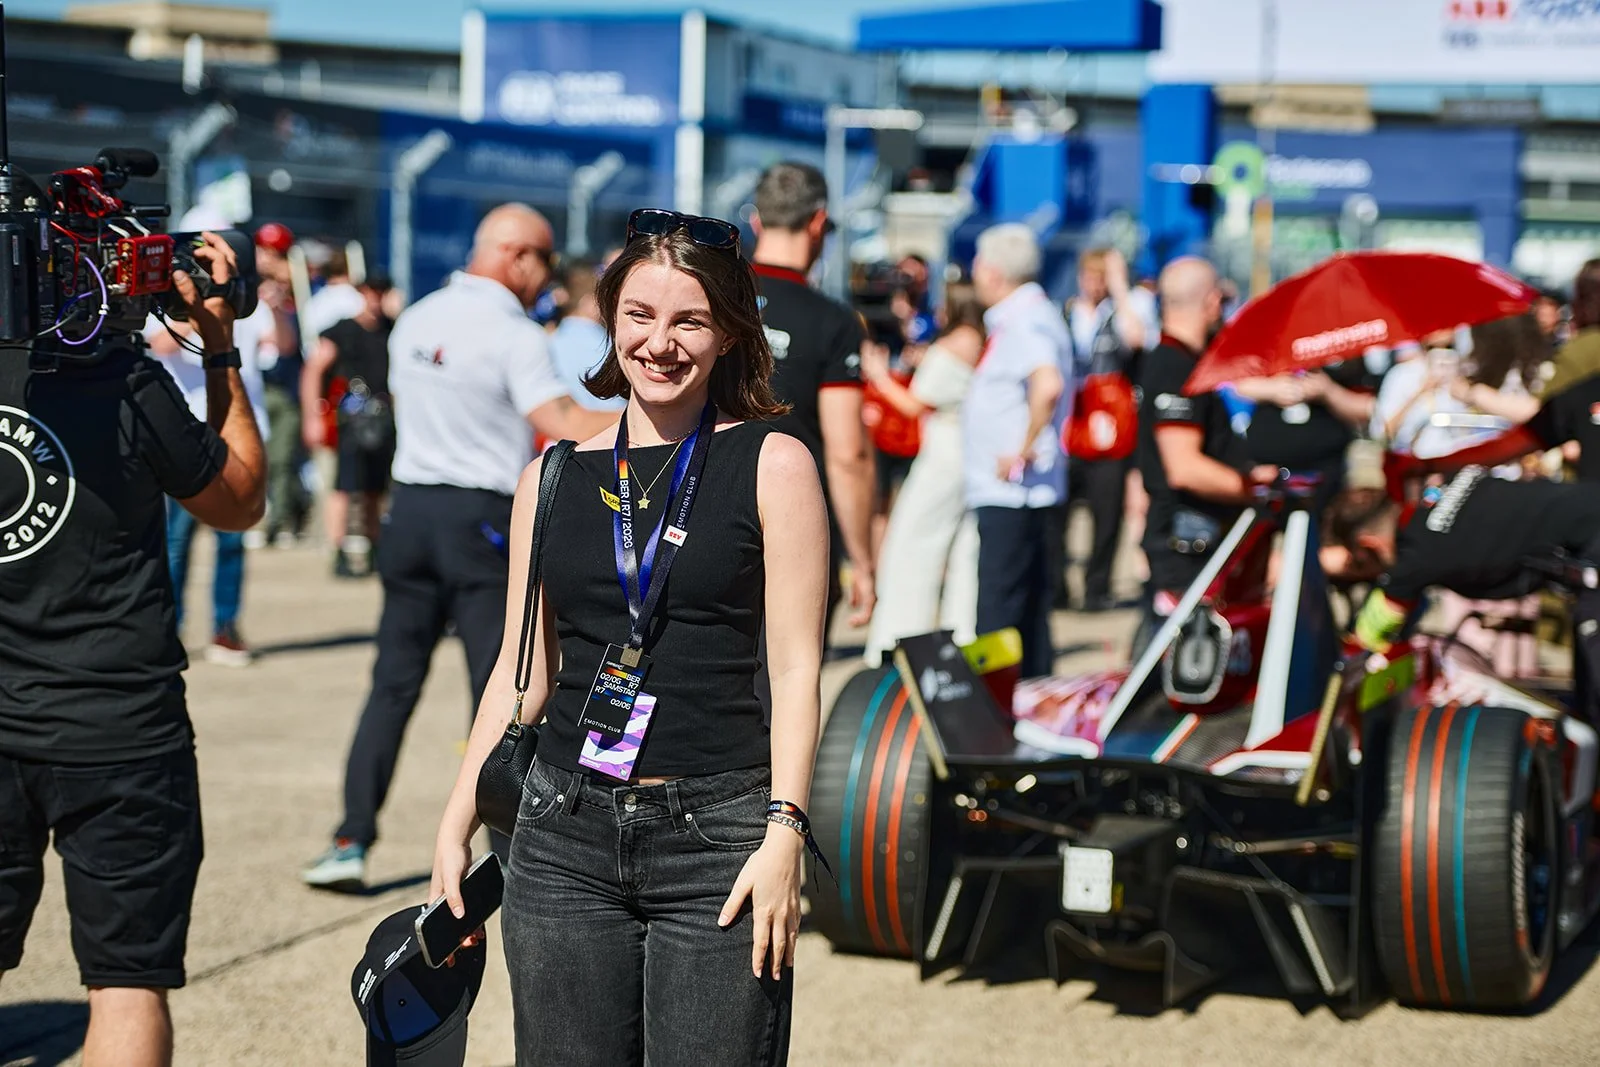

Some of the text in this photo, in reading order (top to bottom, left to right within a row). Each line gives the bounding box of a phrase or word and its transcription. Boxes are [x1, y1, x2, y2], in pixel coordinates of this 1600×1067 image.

[620, 480, 630, 499] BER
[677, 476, 696, 528] EMOTION CLUB
[3, 502, 57, 551] 2012
[626, 674, 641, 684] BER
[627, 680, 639, 690] R7
[595, 686, 606, 694] R7
[603, 680, 636, 697] SAMSTAG
[584, 717, 607, 729] EMOTION
